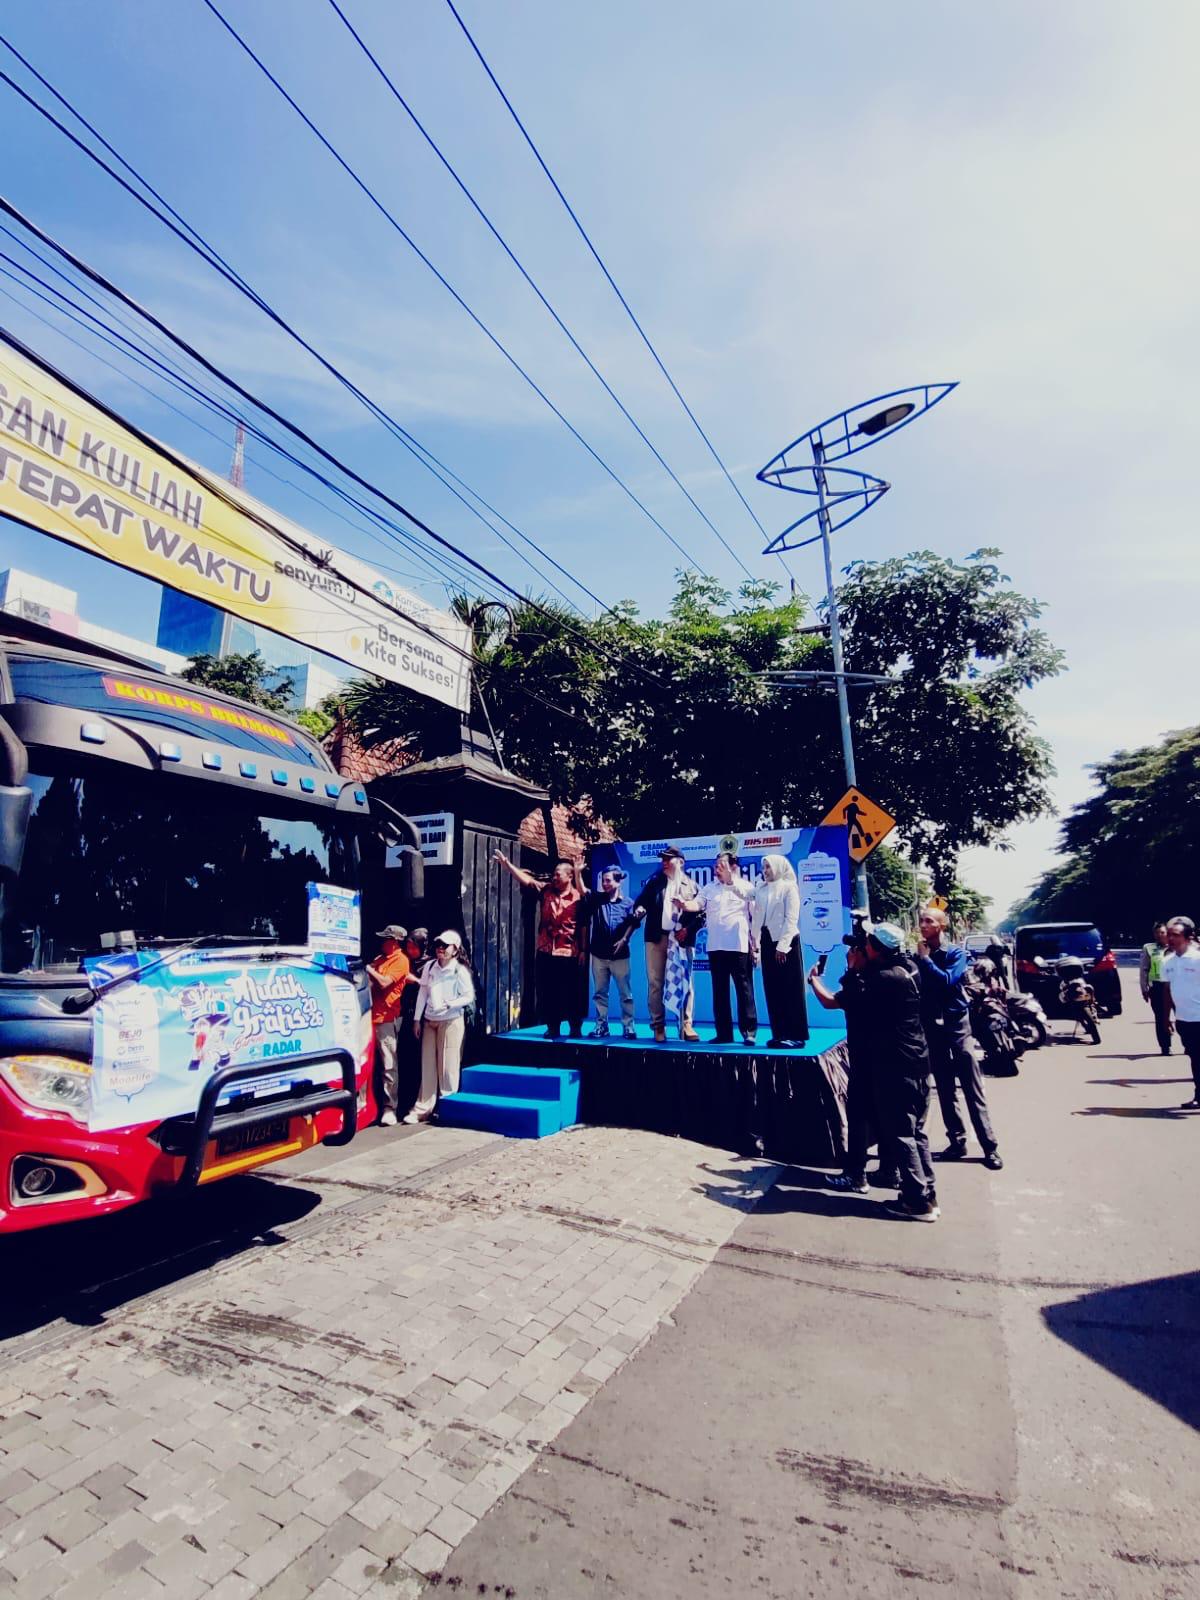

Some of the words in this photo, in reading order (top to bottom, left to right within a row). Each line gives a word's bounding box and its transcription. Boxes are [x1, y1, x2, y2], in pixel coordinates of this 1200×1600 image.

[79, 431, 203, 530] KULIAH
[0, 446, 135, 535] TEPAT
[142, 518, 272, 603] WAKTU
[273, 559, 343, 594] senyum
[364, 638, 397, 666] Kita
[401, 654, 455, 690] Sukses!
[378, 623, 444, 667] Bersama
[114, 681, 204, 715] KORPS
[263, 1039, 302, 1057] RADAR
